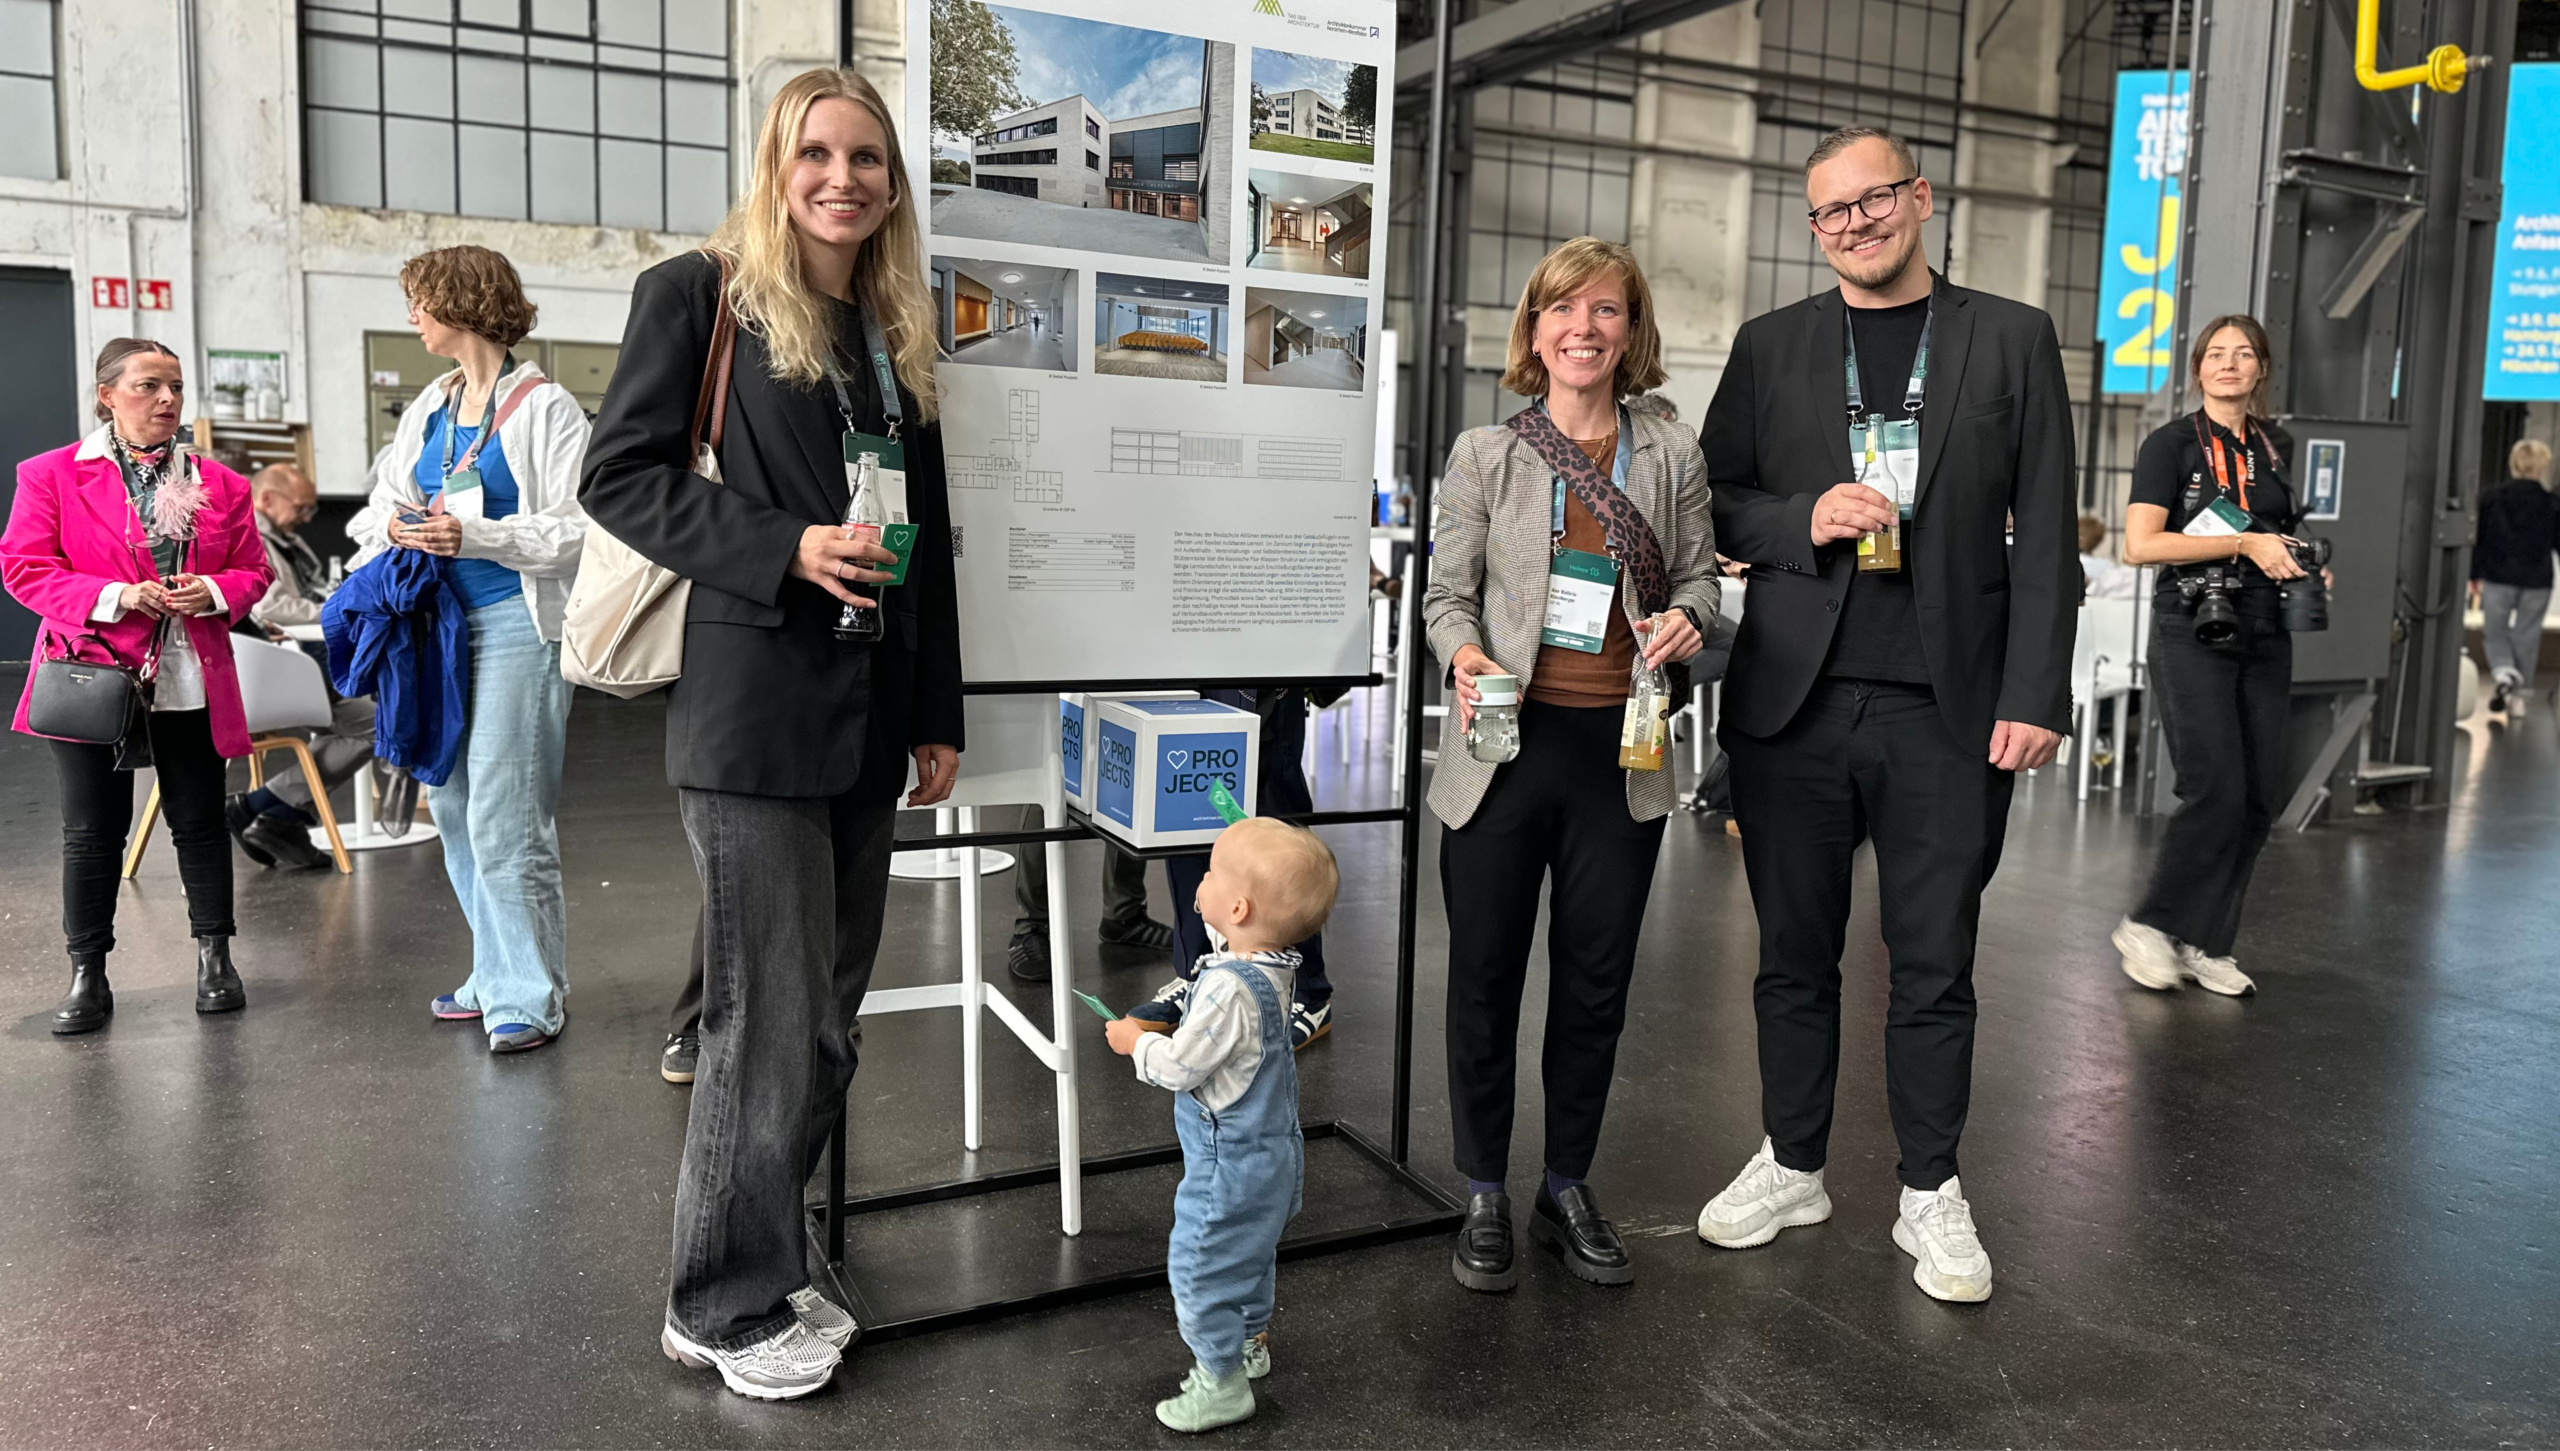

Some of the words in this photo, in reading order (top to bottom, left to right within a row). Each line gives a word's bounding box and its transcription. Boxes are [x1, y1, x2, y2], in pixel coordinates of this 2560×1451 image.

[2113, 288, 2174, 366] 2
[880, 367, 890, 391] Heinze
[2246, 449, 2255, 480] SONY
[1062, 715, 1080, 740] PRO
[1062, 737, 1079, 760] CTS
[1111, 740, 1132, 766] PRO
[1192, 748, 1238, 770] PRO
[1100, 758, 1131, 790] JECTS
